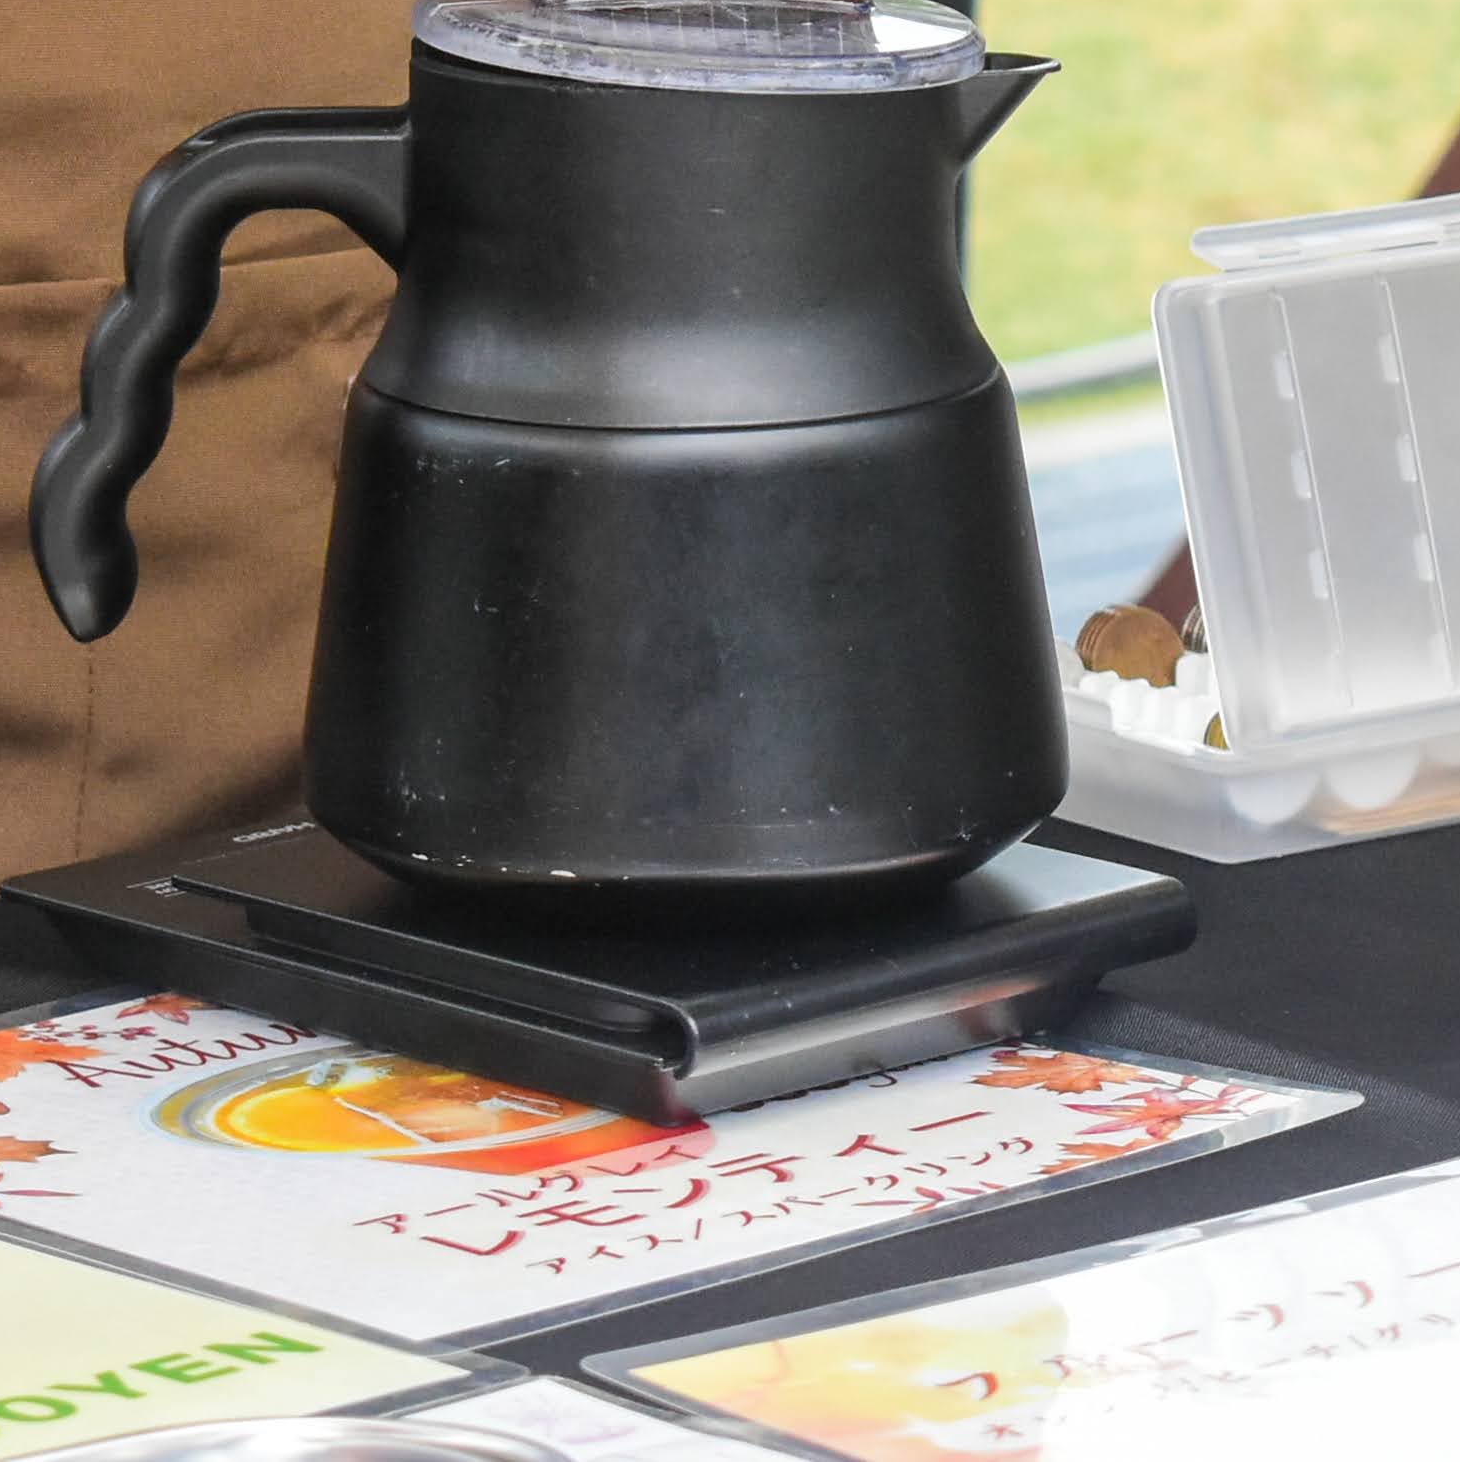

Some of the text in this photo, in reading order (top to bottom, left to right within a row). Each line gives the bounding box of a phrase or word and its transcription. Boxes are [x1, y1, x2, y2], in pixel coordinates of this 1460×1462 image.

[352, 1143, 708, 1235] アールグレイ
[420, 1111, 995, 1257] レモンティー
